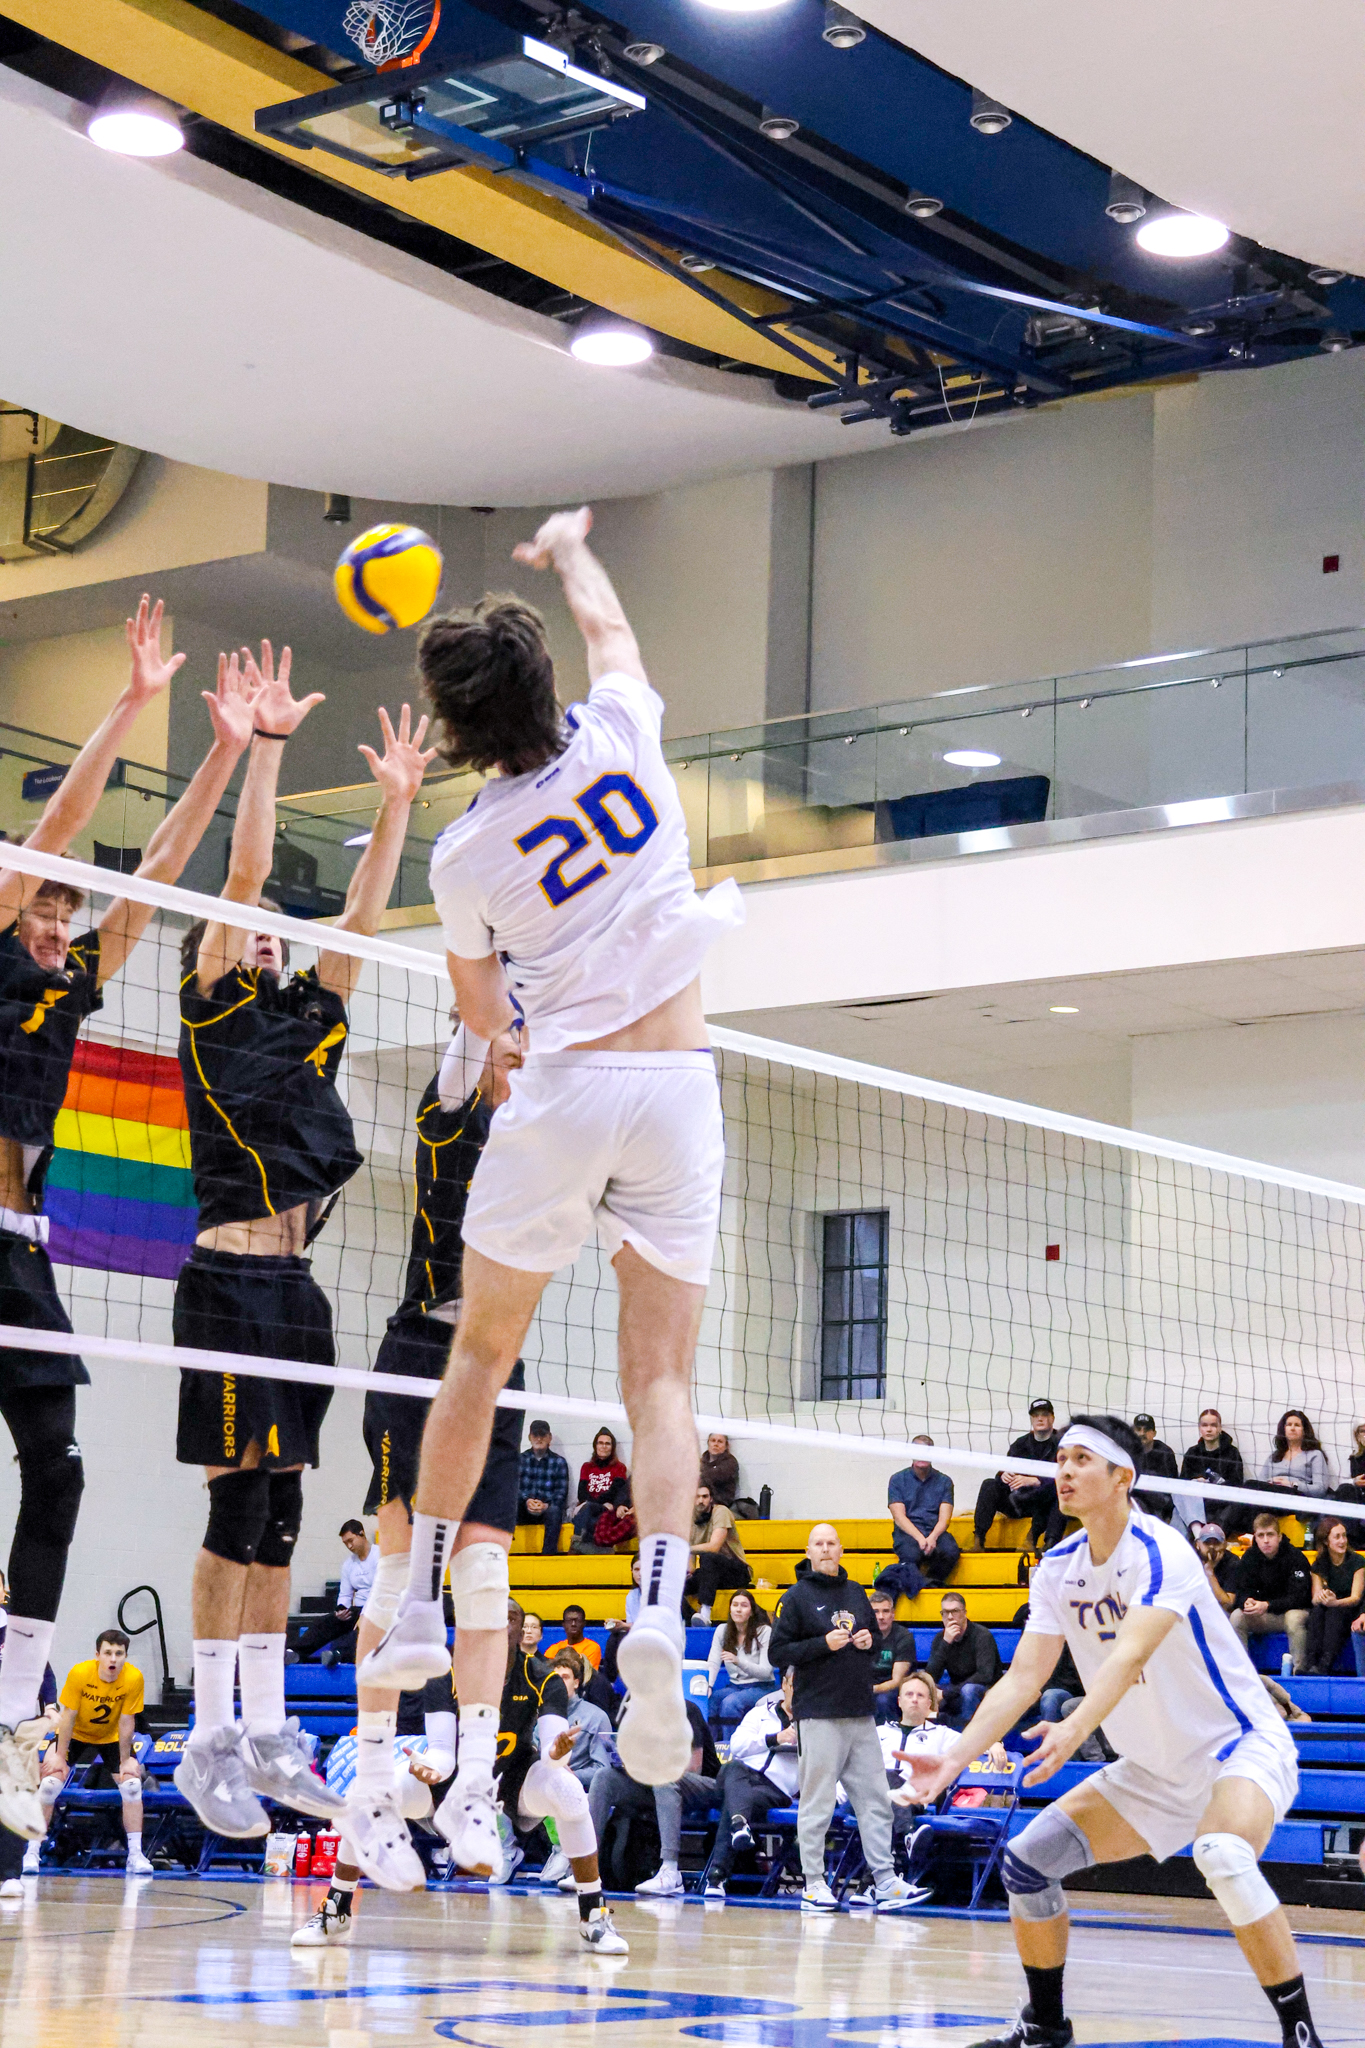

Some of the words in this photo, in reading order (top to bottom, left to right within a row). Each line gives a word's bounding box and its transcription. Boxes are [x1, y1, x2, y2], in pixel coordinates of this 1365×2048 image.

[511, 771, 660, 911] 20
[380, 1429, 392, 1505] WARRIOR
[90, 1704, 112, 1725] 2
